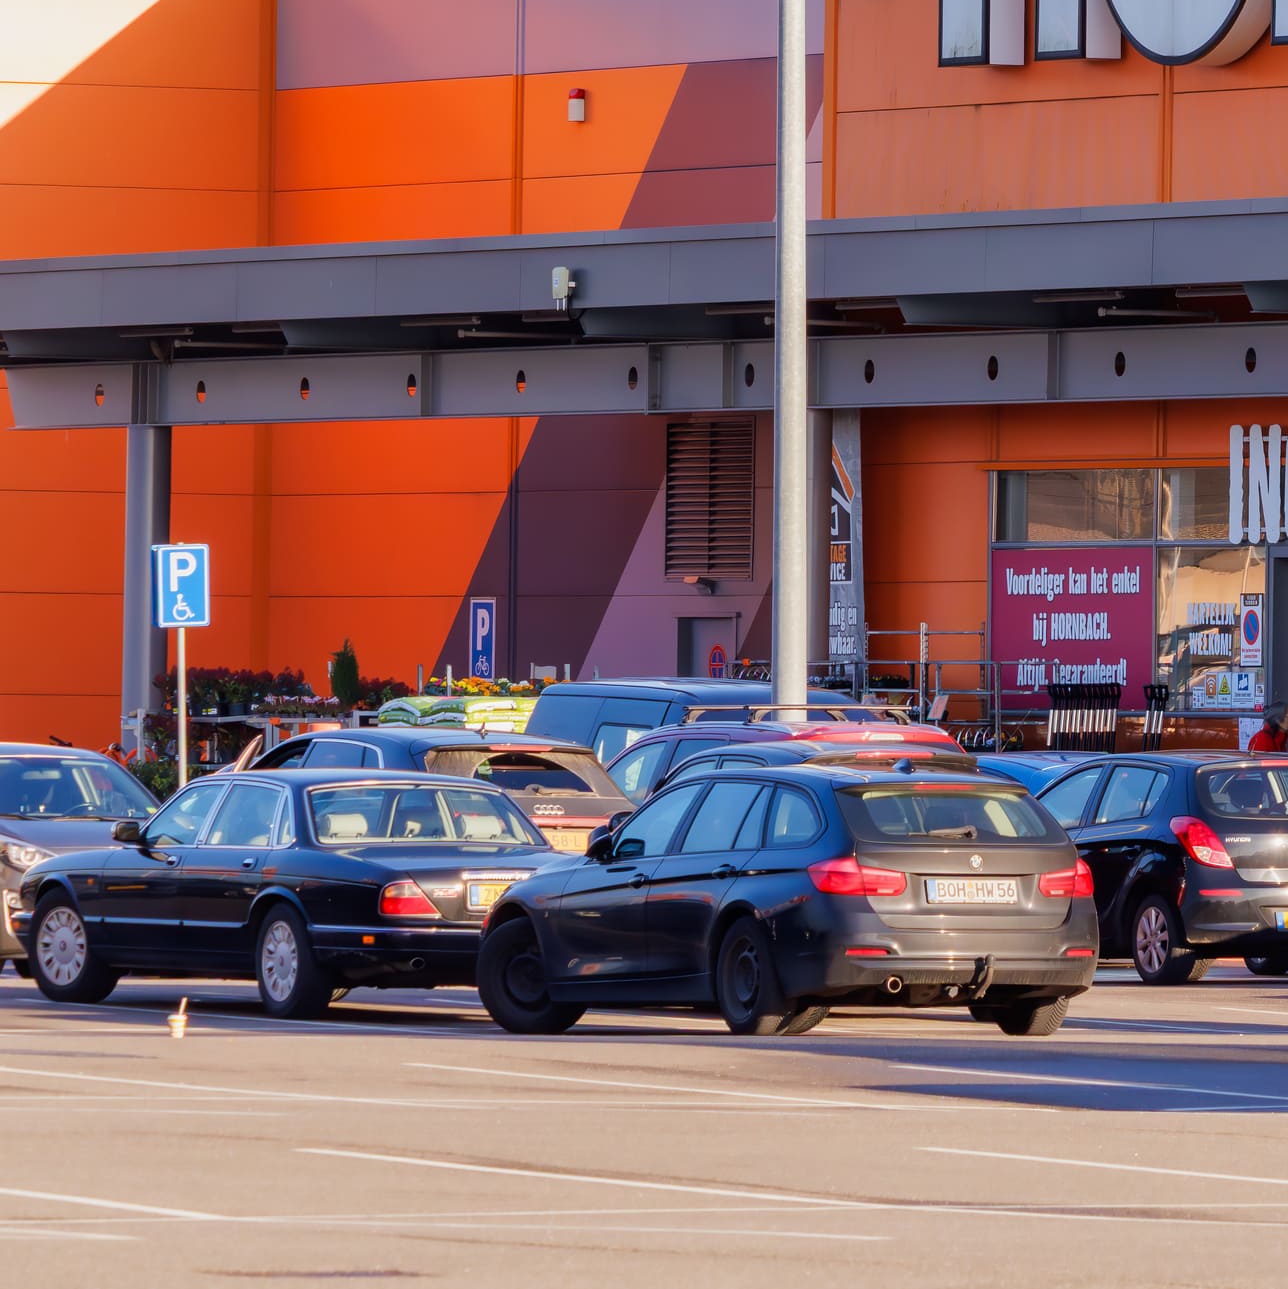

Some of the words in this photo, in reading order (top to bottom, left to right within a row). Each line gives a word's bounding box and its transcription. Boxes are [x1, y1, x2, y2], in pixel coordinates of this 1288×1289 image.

[170, 551, 197, 592] P
[1006, 567, 1065, 601] Voordeliger
[1068, 567, 1087, 594] kan
[1091, 566, 1108, 594] het
[1112, 566, 1140, 594] enkel
[477, 608, 489, 651] P
[848, 607, 857, 626] en
[1033, 613, 1047, 647] bij
[1051, 612, 1111, 640] HORNBACH.
[1189, 632, 1232, 657] WELKOM!
[937, 882, 966, 898] BOH
